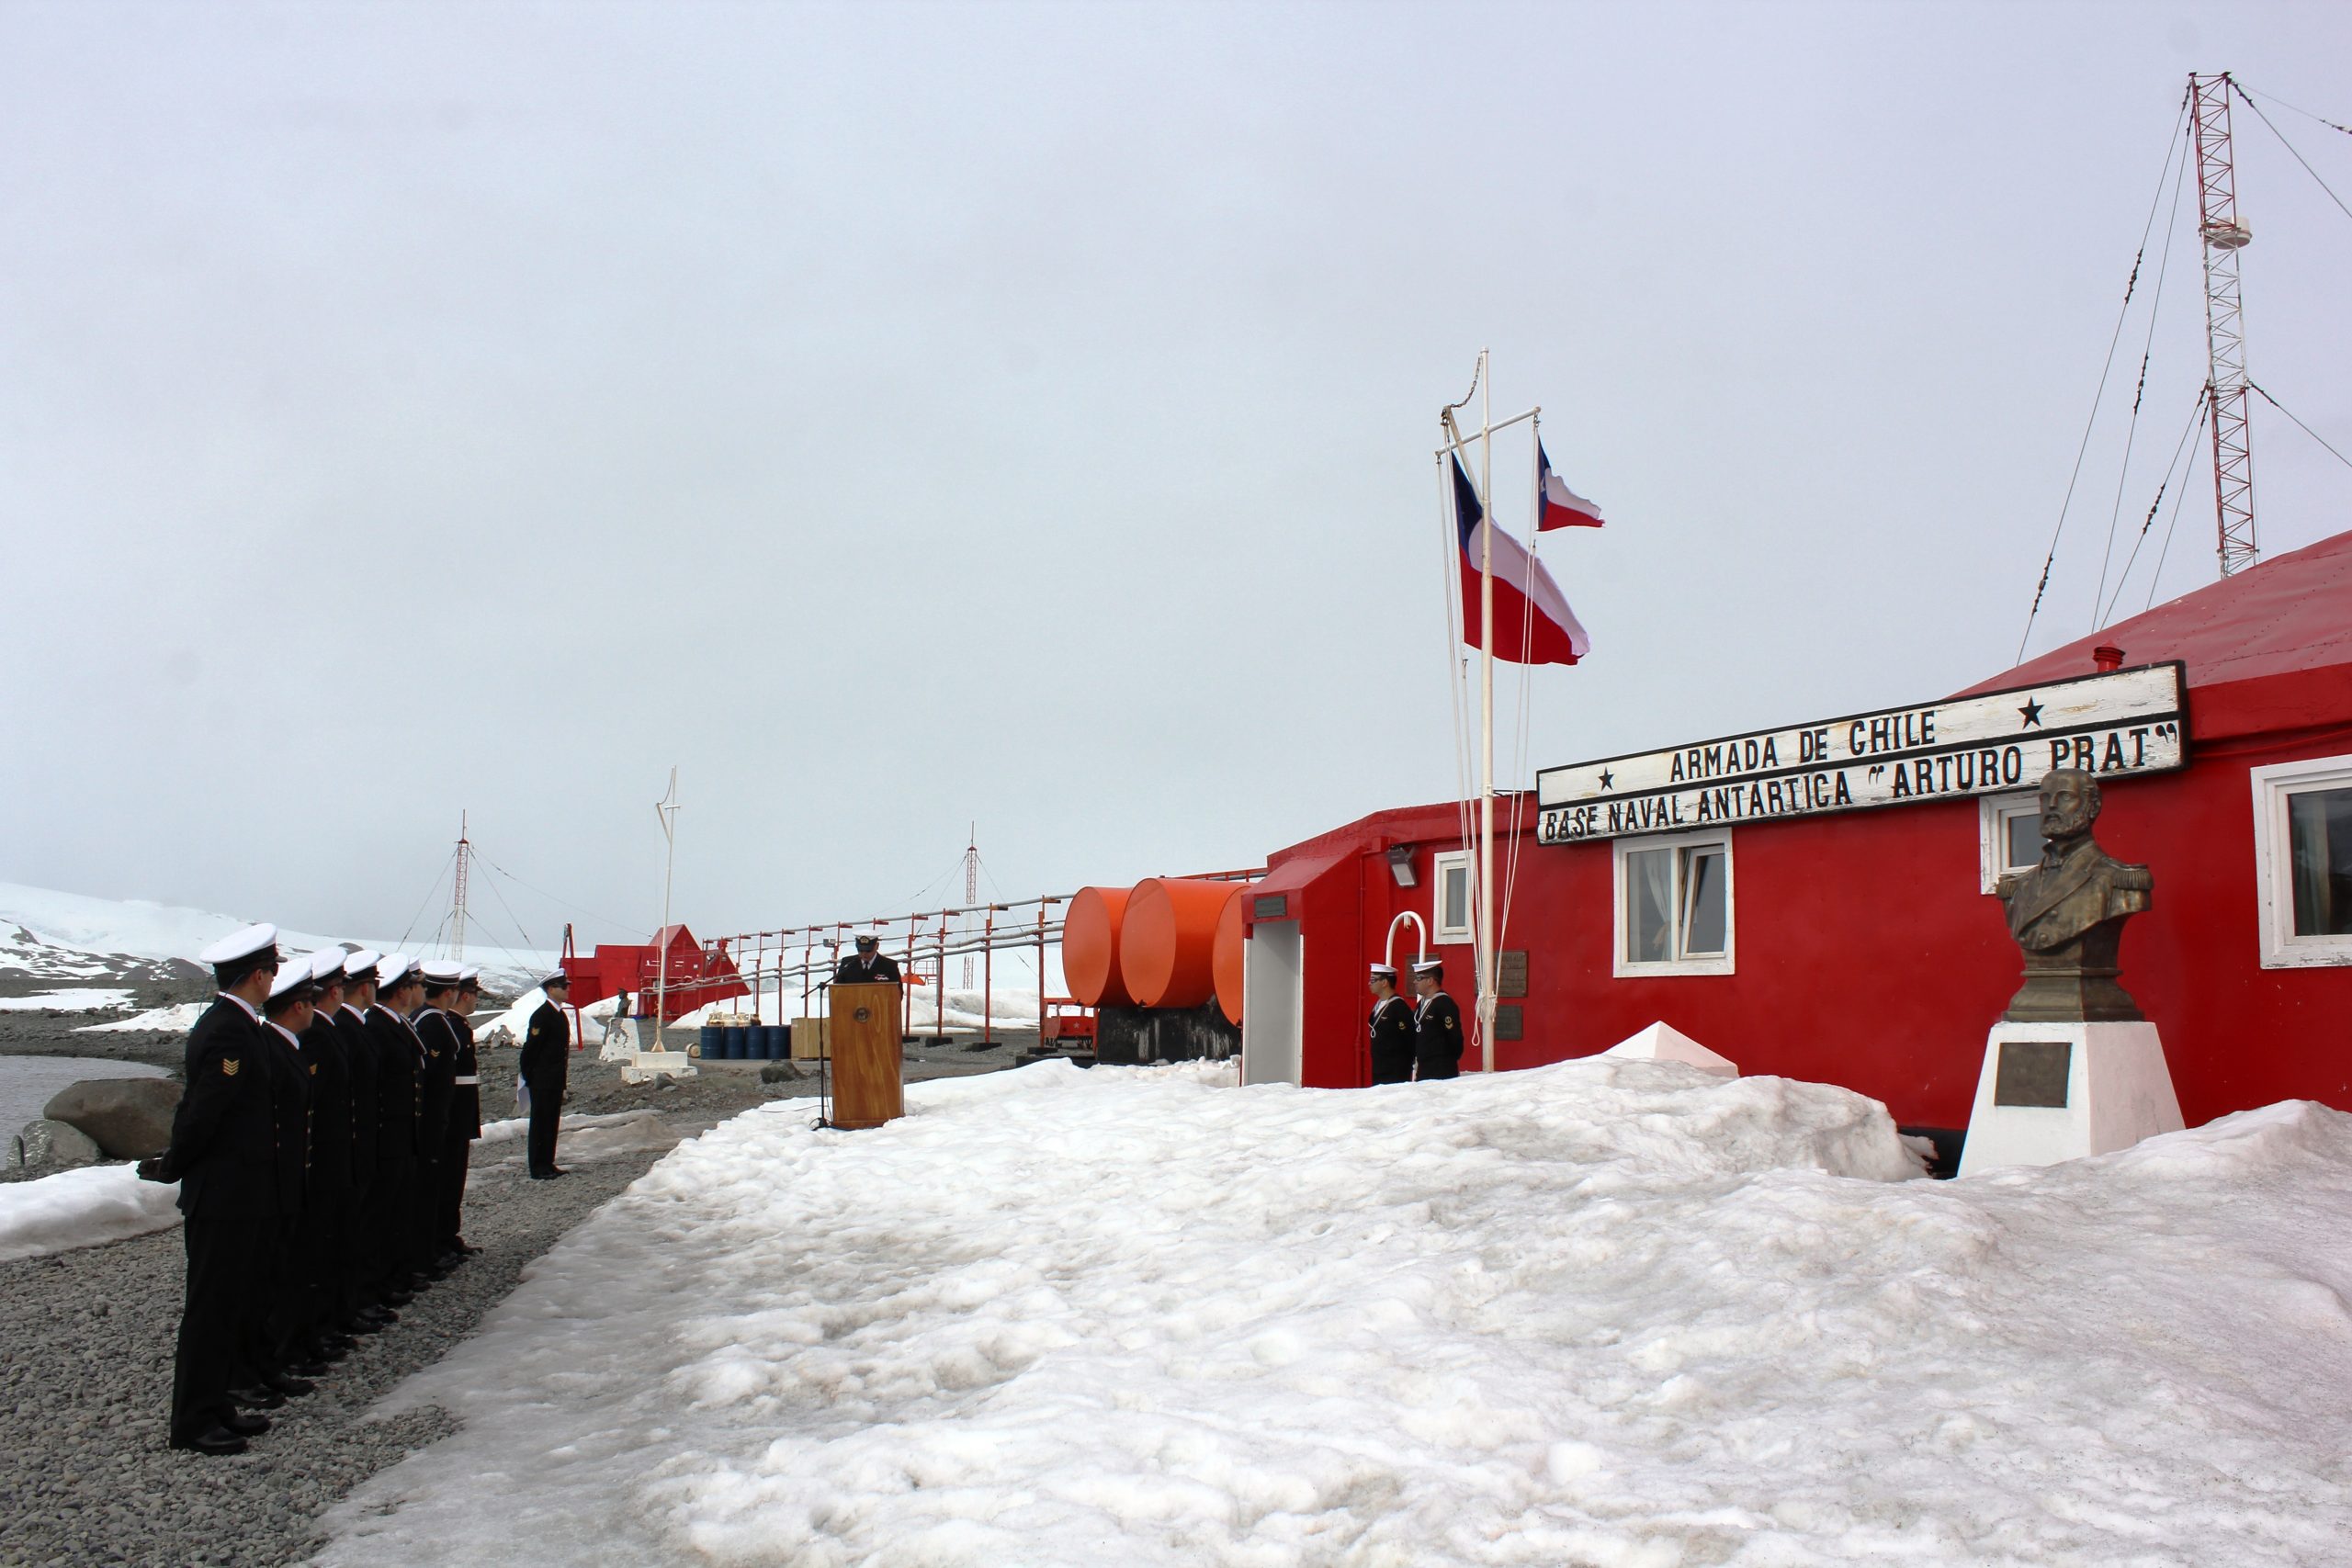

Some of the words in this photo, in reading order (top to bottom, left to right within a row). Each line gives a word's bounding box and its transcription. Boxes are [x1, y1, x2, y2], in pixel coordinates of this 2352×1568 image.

[1670, 737, 1779, 782] ARMADA
[1799, 728, 1827, 763] DE
[1849, 711, 1935, 755] CHILE
[1545, 806, 1597, 840] BASE
[1608, 795, 1683, 832] NAVAL
